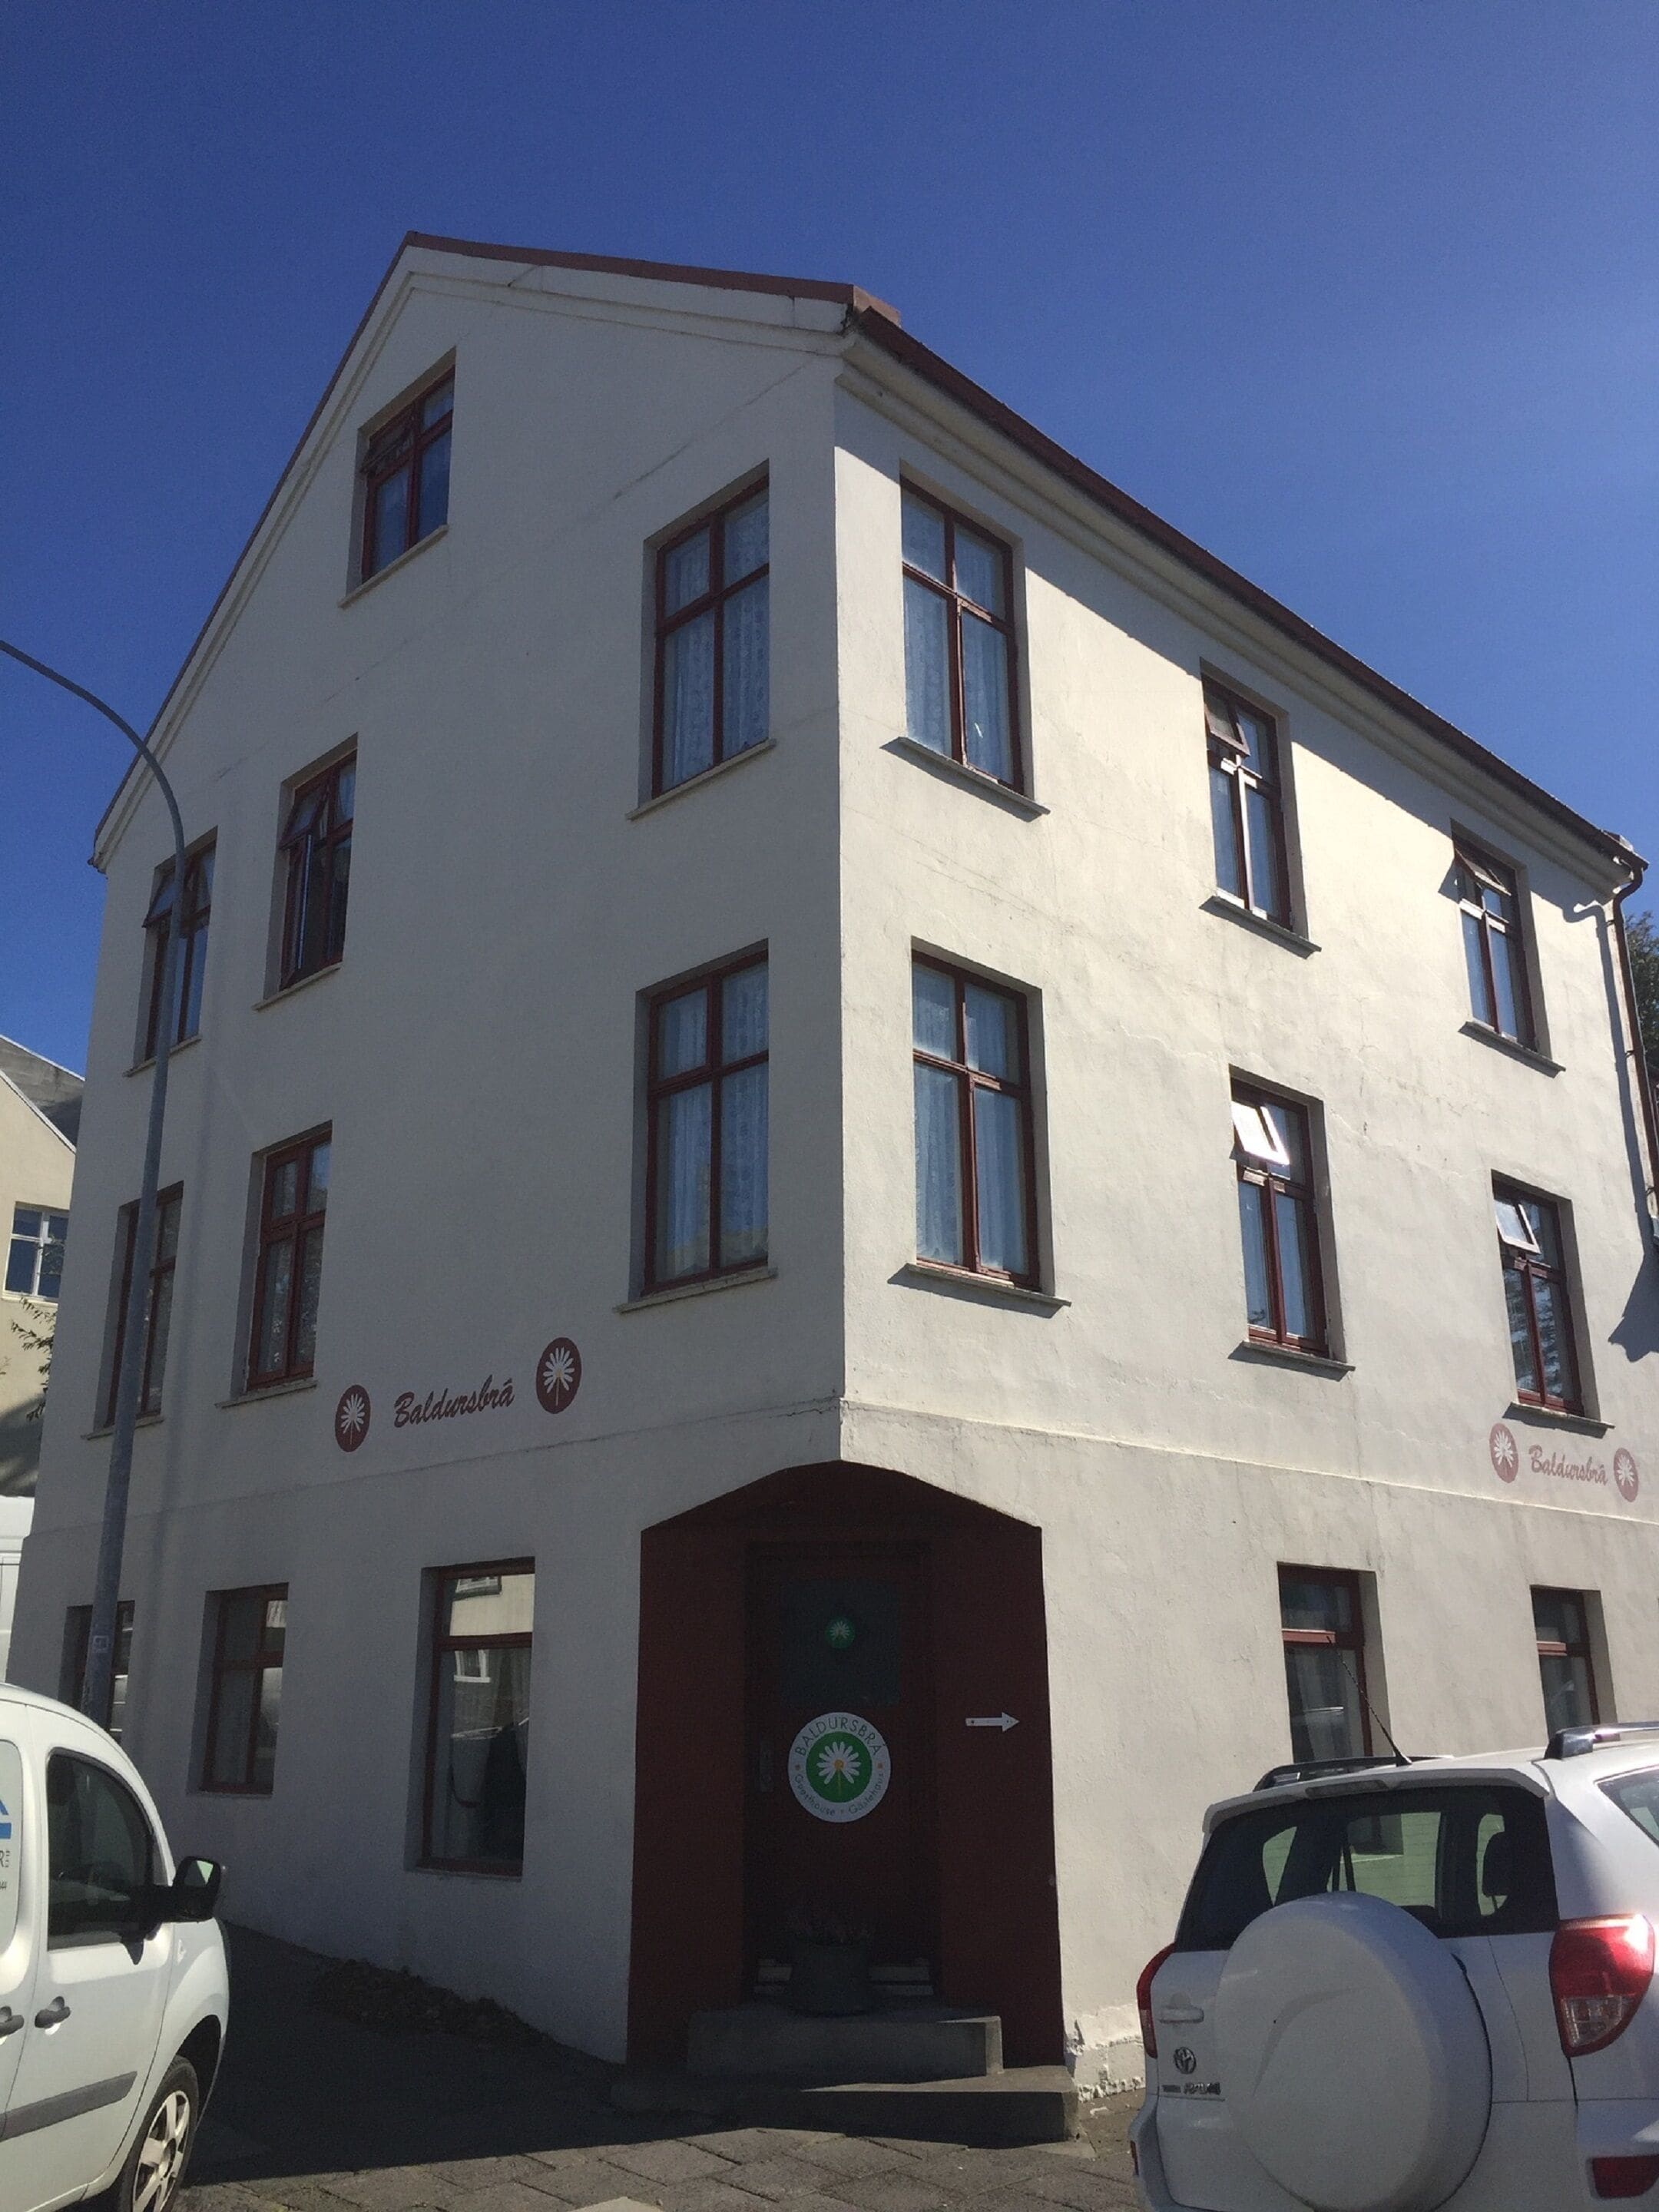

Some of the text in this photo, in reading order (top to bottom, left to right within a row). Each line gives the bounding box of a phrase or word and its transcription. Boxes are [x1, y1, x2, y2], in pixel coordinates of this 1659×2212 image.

[393, 1374, 515, 1428] Baldursbrá
[1528, 1445, 1608, 1485] Baldursbrá
[794, 1716, 886, 1757] BALDURSBRÁ
